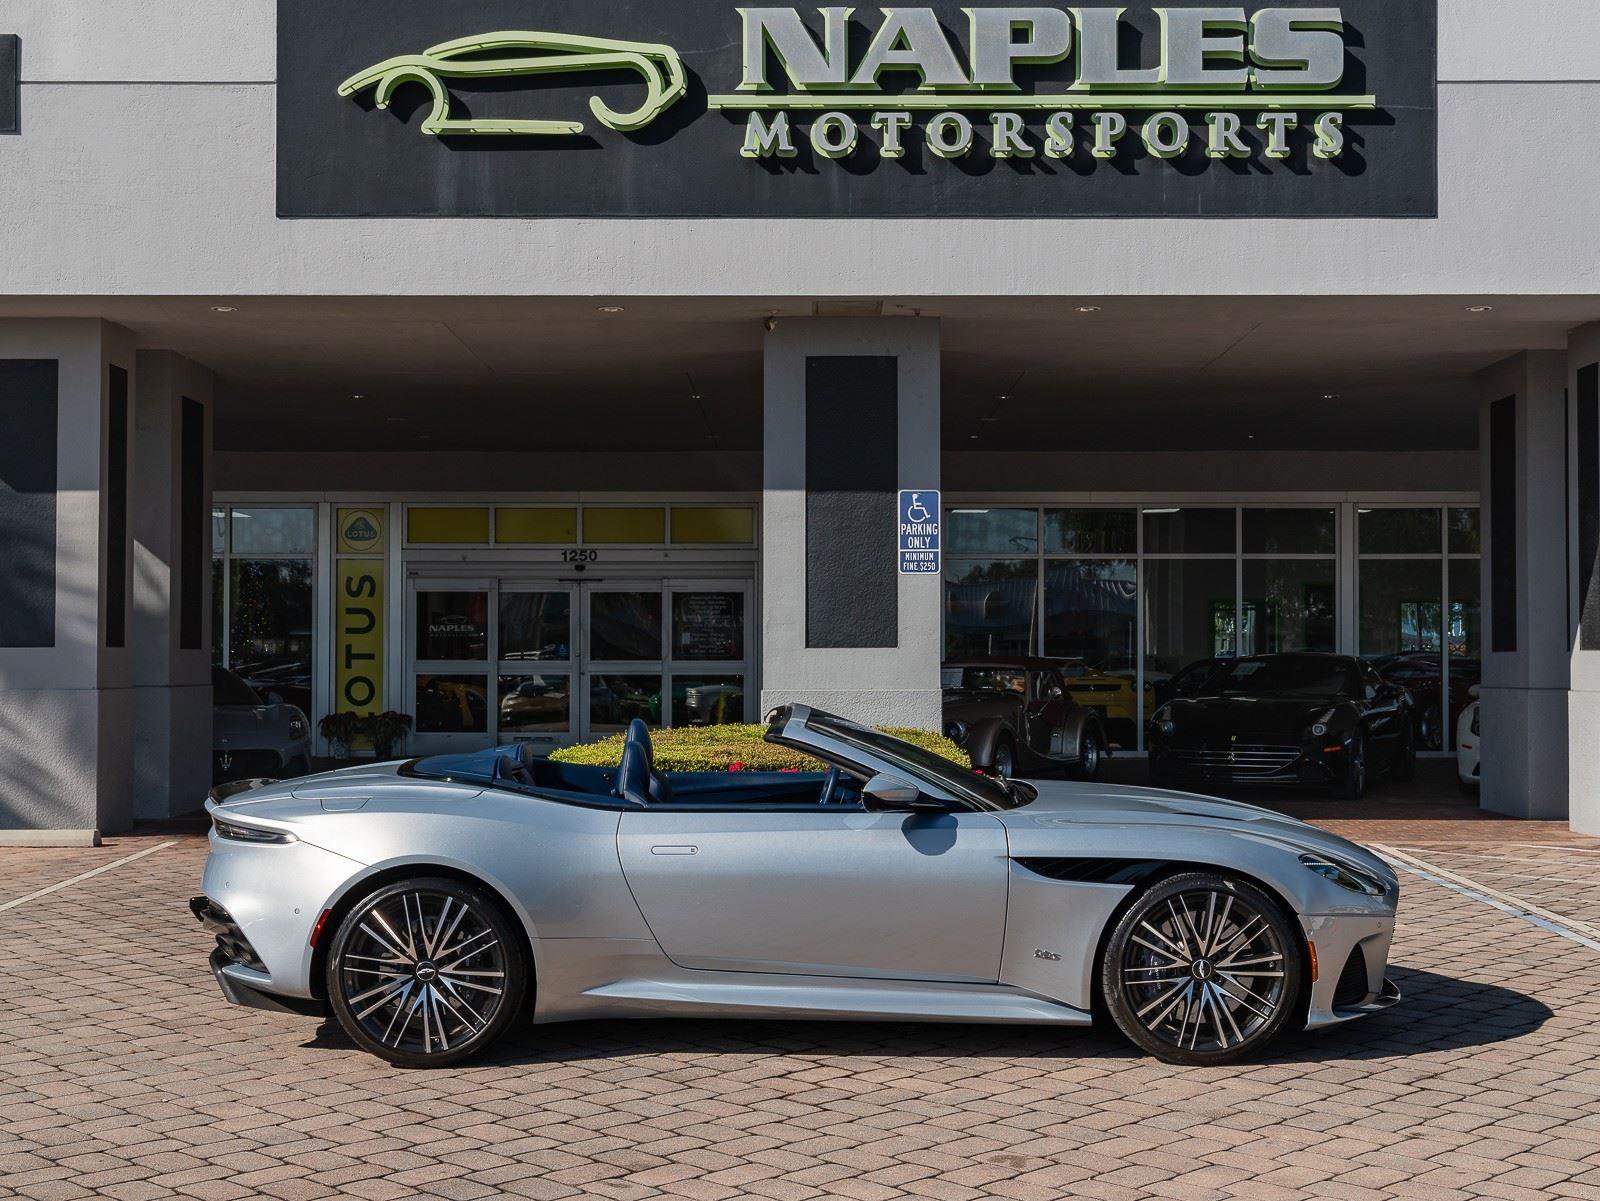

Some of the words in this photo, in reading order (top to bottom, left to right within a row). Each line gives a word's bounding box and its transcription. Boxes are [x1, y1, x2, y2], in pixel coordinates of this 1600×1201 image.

[735, 7, 1345, 91] NAPLES
[740, 111, 1345, 159] MOTORSPORTS
[347, 529, 376, 538] LOTUS
[900, 523, 938, 535] PARKING
[908, 537, 931, 548] ONLY
[561, 550, 598, 562] 1250
[905, 552, 934, 560] MINIMUM
[903, 562, 918, 571] FINE
[920, 562, 936, 571] $250
[428, 624, 475, 632] NAPLES
